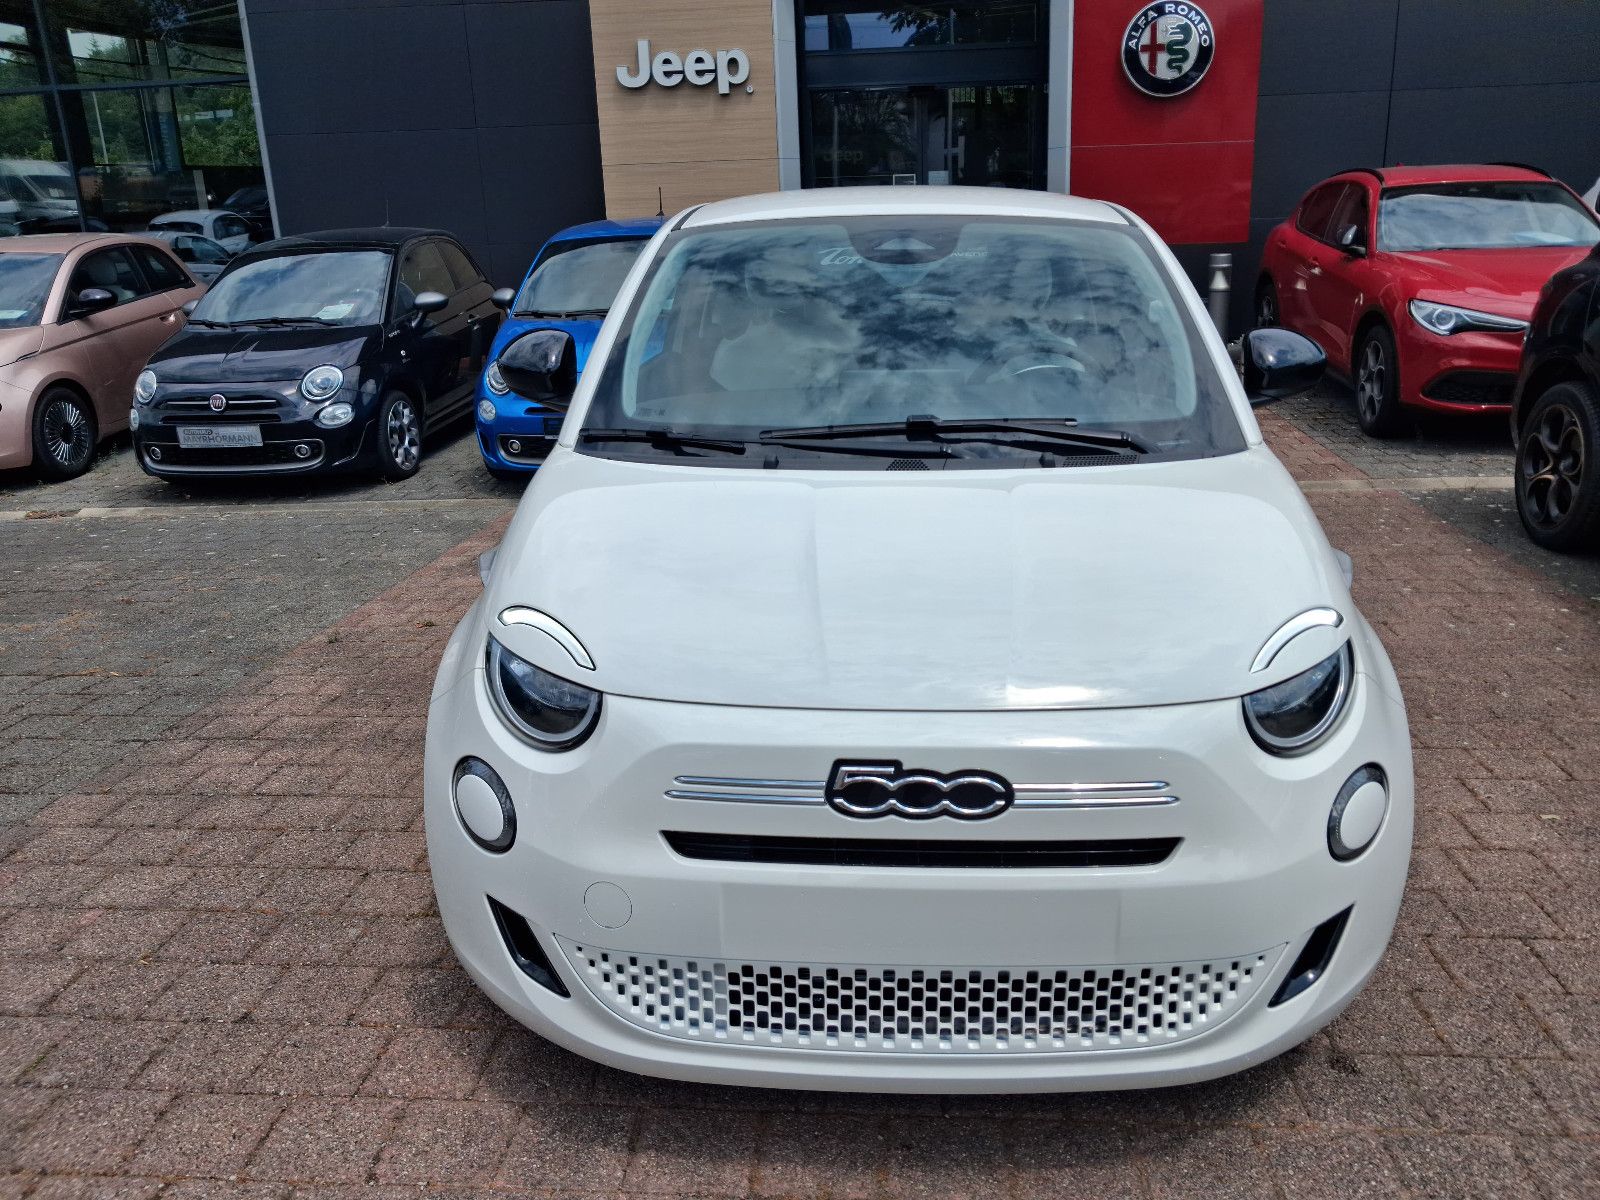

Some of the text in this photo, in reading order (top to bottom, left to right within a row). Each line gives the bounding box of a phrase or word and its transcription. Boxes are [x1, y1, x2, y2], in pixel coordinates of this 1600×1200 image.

[1128, 3, 1210, 50] ALFA ROMEO
[616, 39, 750, 95] Jeep
[830, 762, 1010, 817] 500
